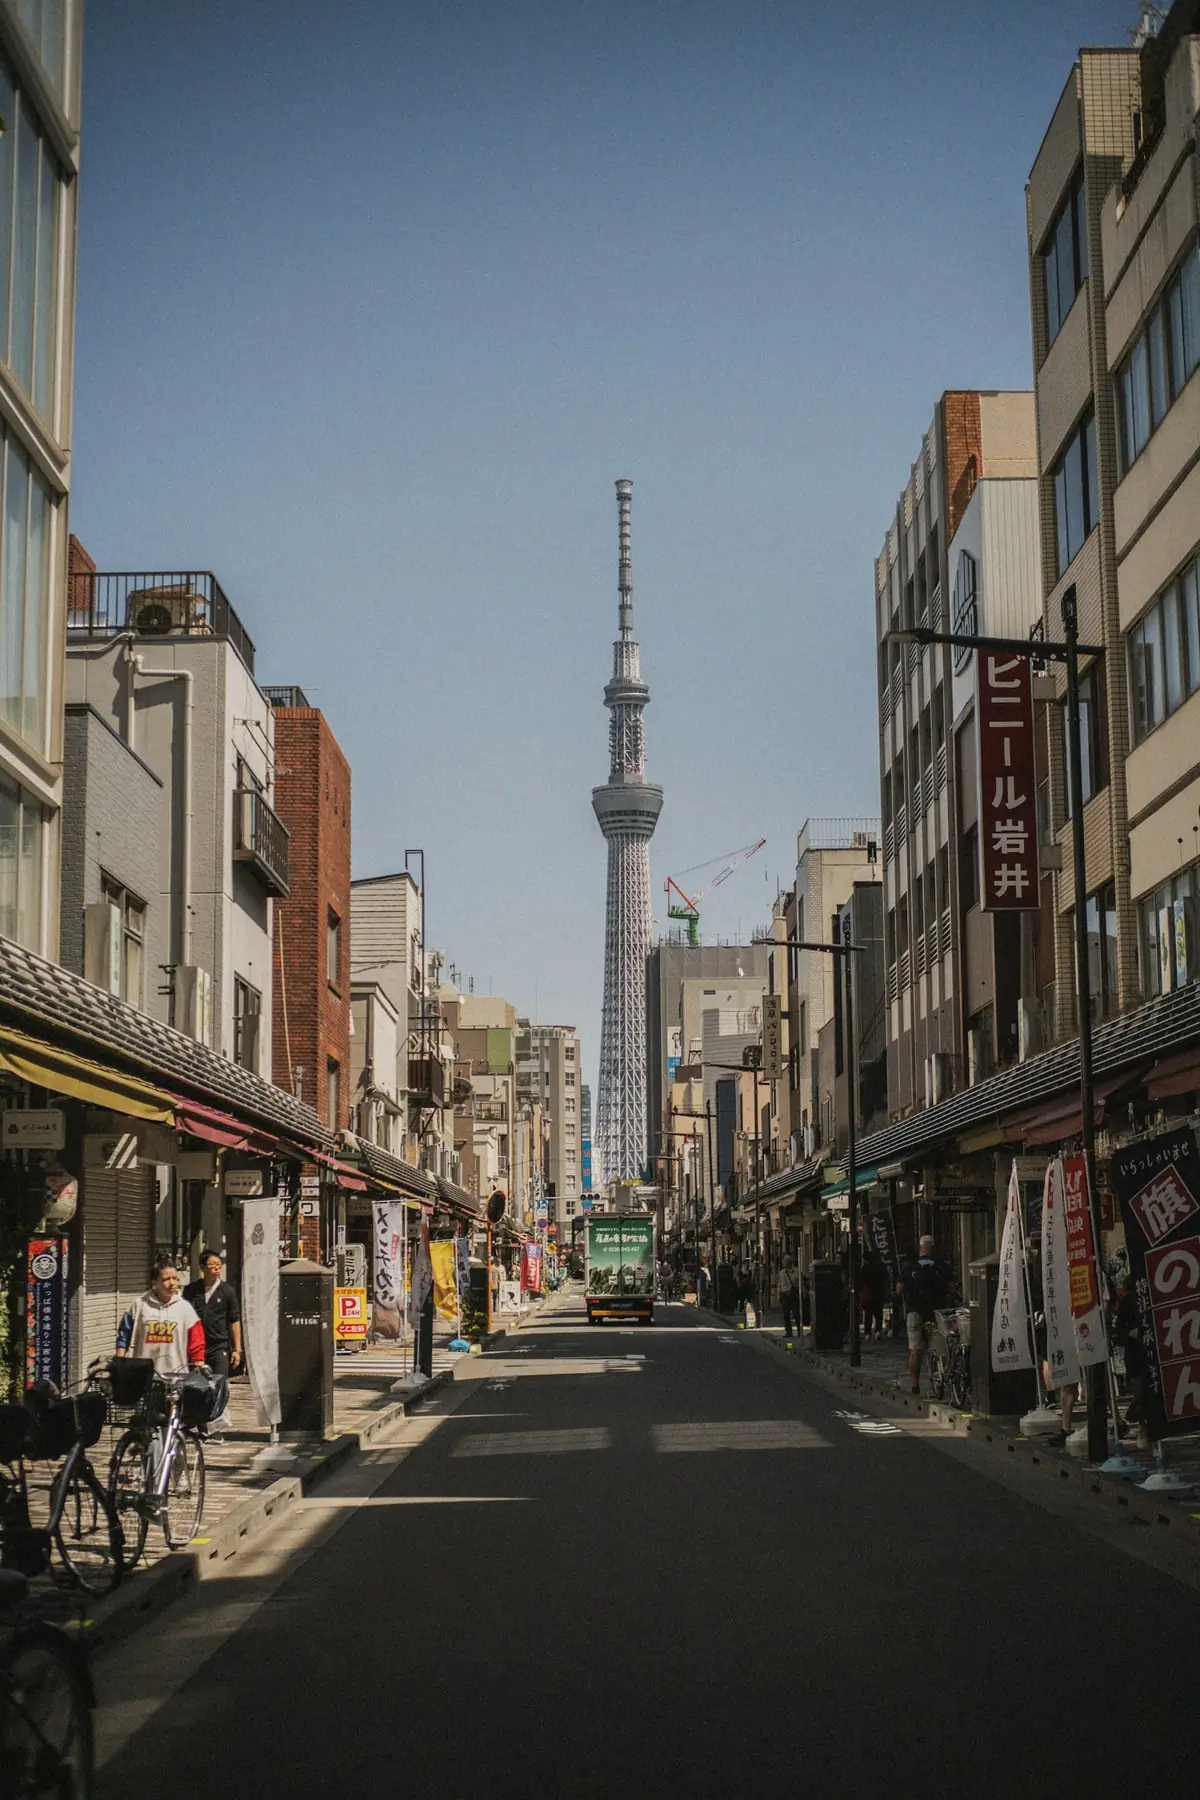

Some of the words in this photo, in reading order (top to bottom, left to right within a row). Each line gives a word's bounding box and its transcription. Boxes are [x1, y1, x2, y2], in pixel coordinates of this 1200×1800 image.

[987, 654, 1030, 899] ビニール岩井
[1120, 1141, 1190, 1176] いらっしゃいませ
[1139, 1174, 1191, 1239] 旗
[871, 1215, 893, 1264] たばこ
[145, 1320, 178, 1336] TOY
[341, 1298, 356, 1316] P
[1153, 1249, 1200, 1416] のれん
[1135, 1278, 1160, 1395] 特注も承ります
